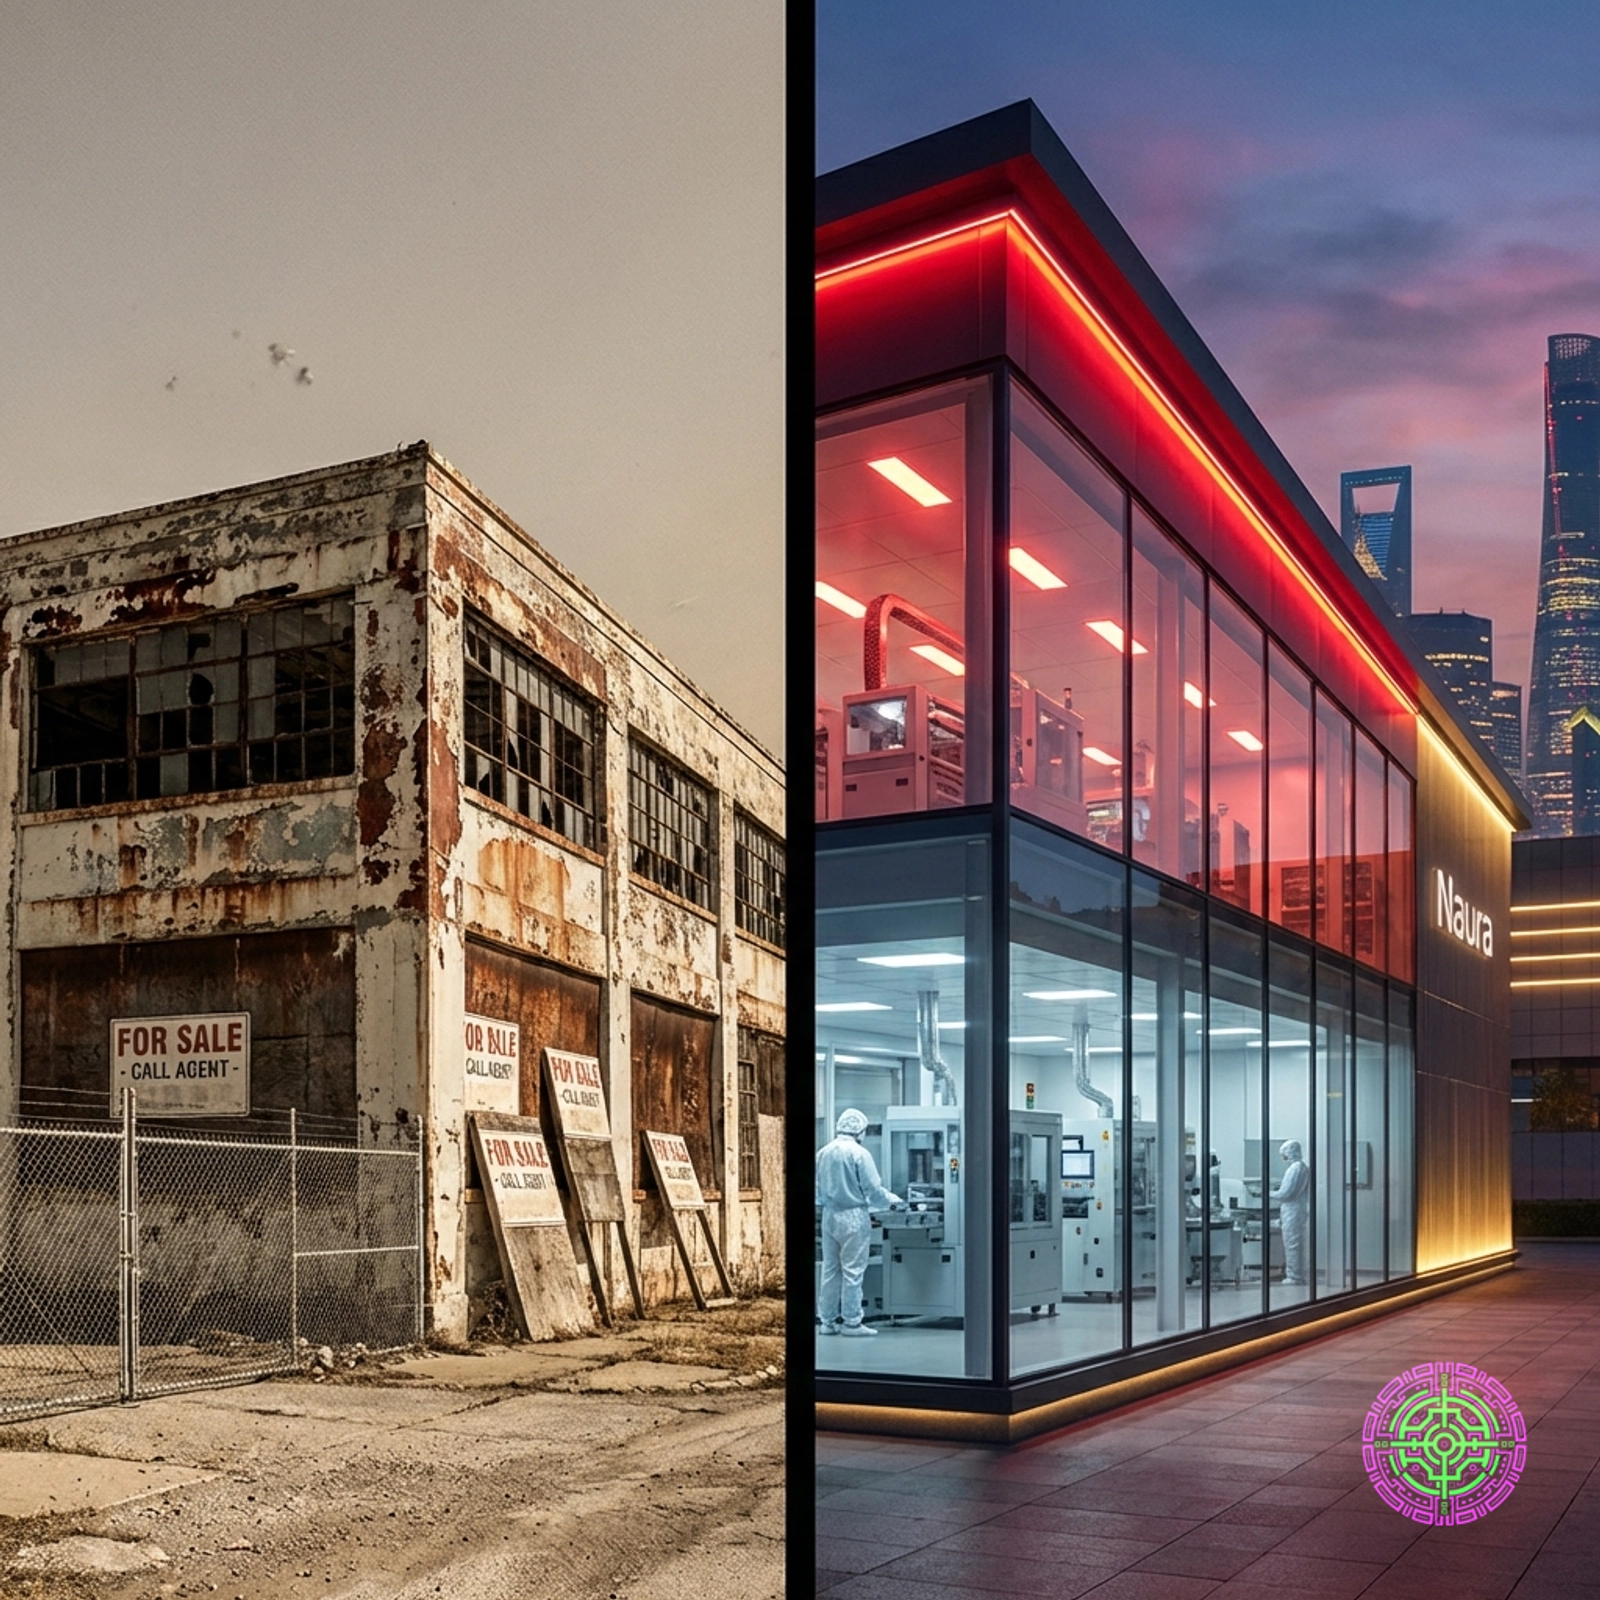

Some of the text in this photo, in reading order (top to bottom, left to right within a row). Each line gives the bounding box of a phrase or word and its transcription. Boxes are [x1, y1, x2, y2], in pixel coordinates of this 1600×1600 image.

[1437, 868, 1493, 957] Naura
[118, 1022, 242, 1057] FOR SALE
[131, 1062, 171, 1080] CALL
[175, 1059, 230, 1079] AGENT
